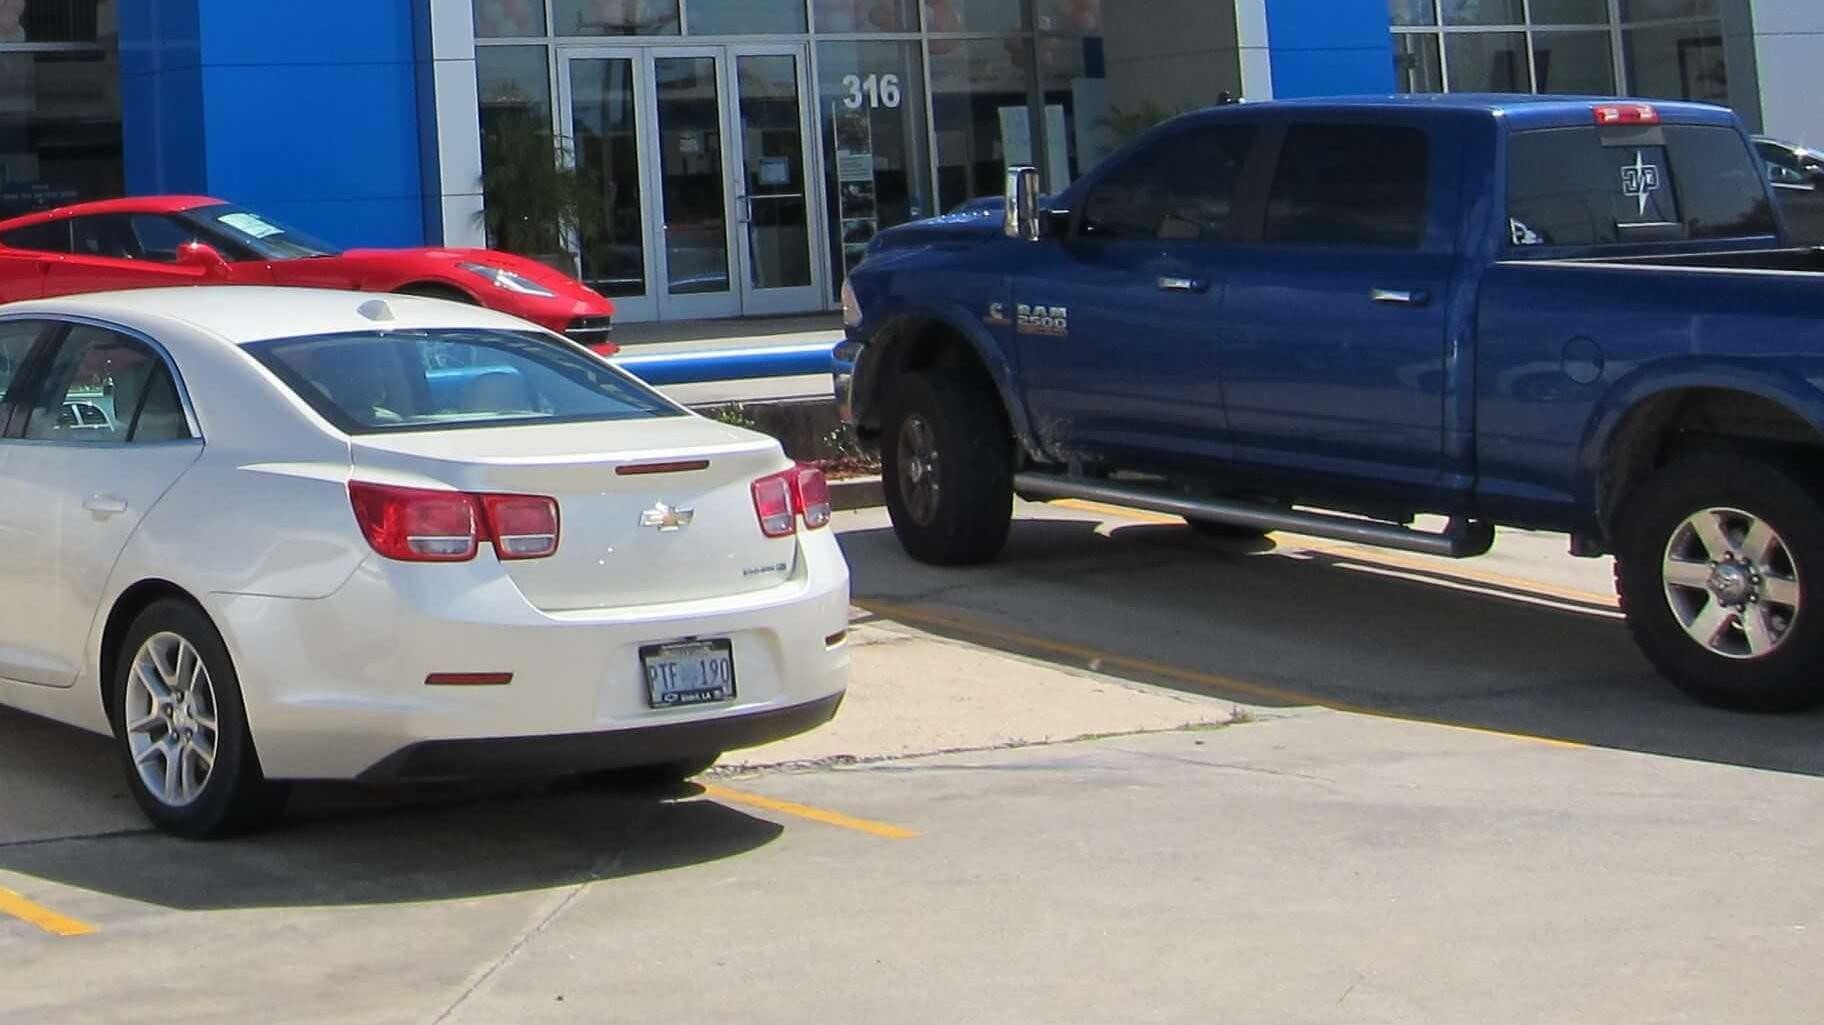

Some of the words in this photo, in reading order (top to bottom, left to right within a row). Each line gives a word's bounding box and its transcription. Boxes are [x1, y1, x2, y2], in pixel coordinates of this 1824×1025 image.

[842, 73, 901, 109] 316
[1017, 304, 1067, 318] RAM
[1017, 315, 1068, 328] 2500
[700, 657, 729, 686] 190
